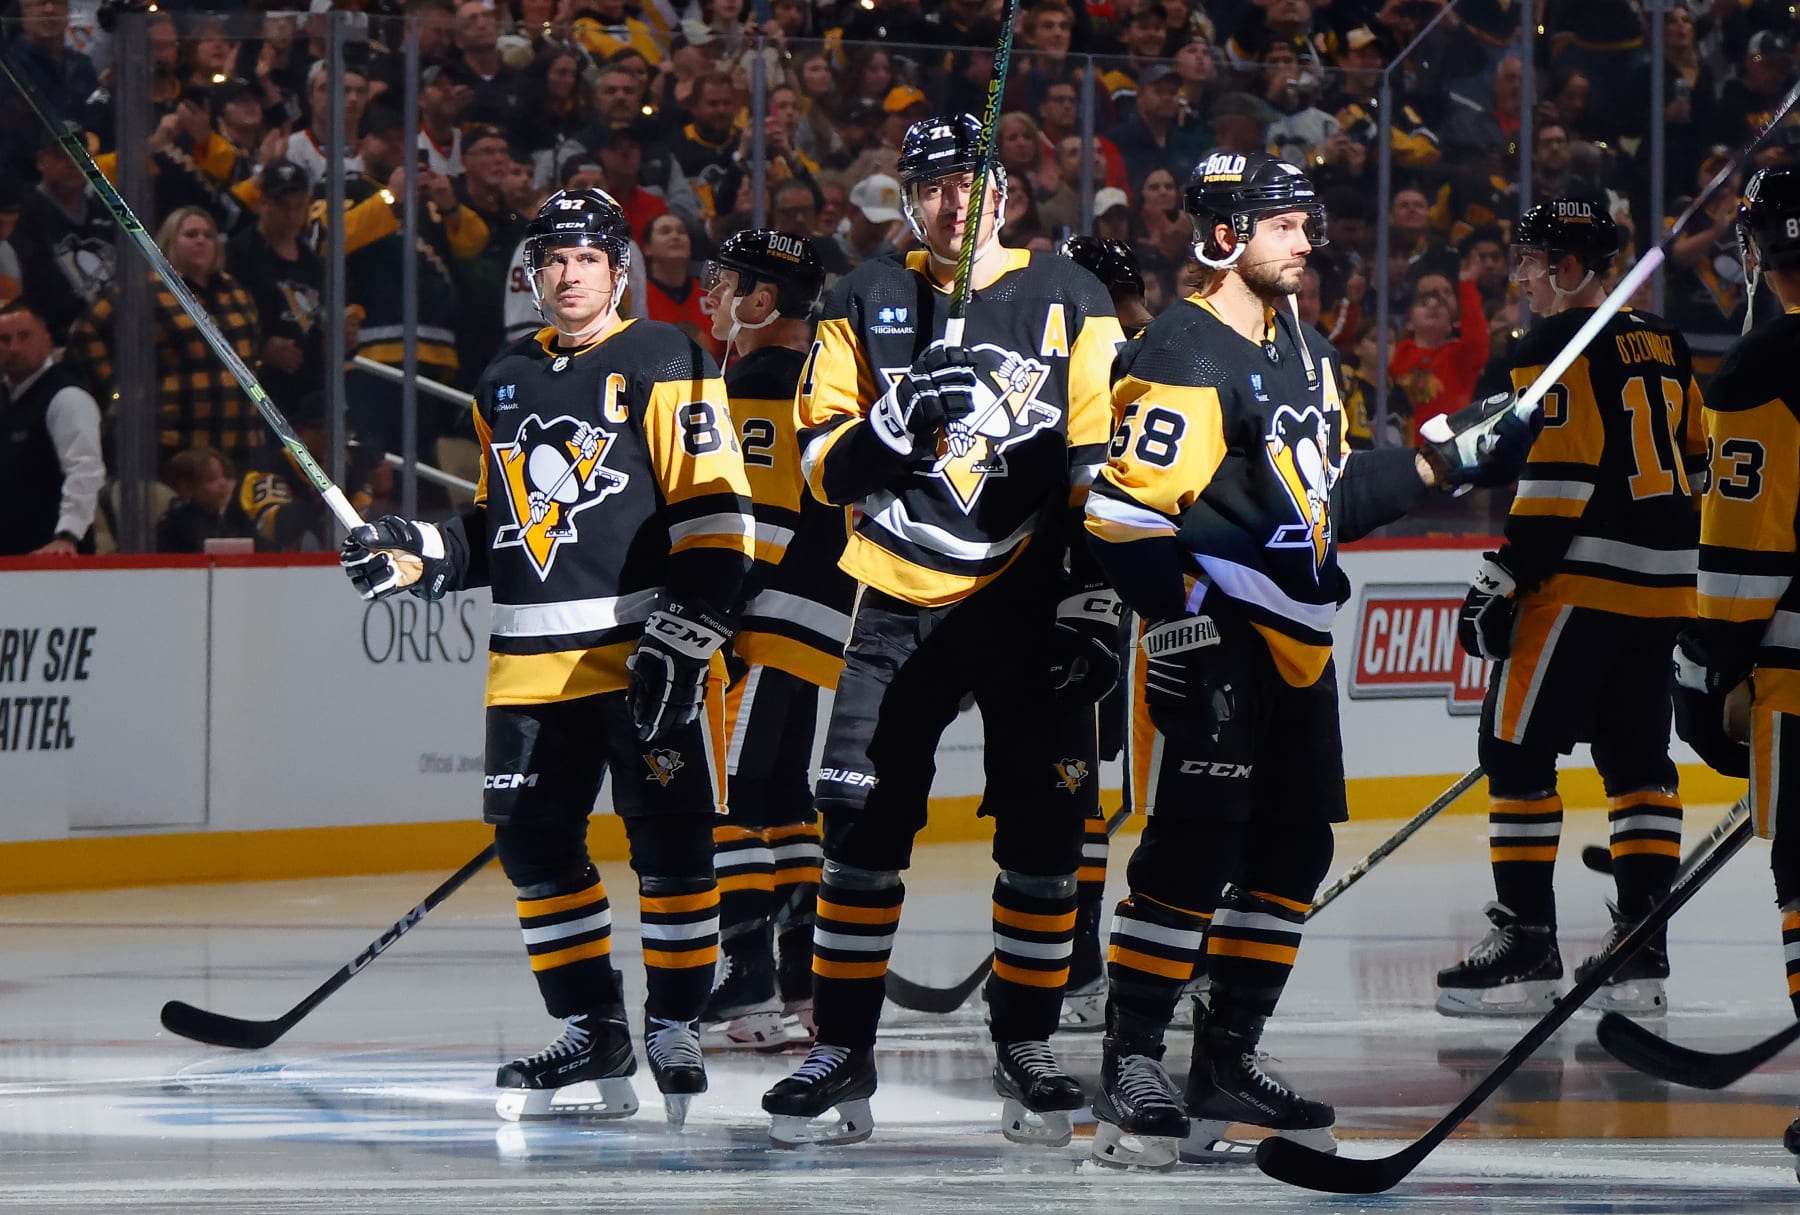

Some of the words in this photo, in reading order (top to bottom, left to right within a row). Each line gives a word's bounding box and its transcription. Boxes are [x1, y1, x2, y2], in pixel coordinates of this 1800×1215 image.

[977, 79, 999, 156] TACKS
[929, 125, 953, 140] 71
[1204, 153, 1247, 175] BOLD
[1203, 174, 1242, 183] PENGUIN
[560, 199, 585, 210] 87
[1558, 202, 1591, 217] BOLD
[766, 249, 801, 263] PENGUIN
[768, 234, 803, 257] BOLD
[872, 326, 914, 334] HIGHMARK
[1041, 303, 1069, 357] A
[1321, 357, 1341, 412] A
[604, 373, 629, 423] C
[1108, 402, 1189, 470] 58
[669, 602, 684, 614] 87
[361, 590, 476, 664] ORR'S
[700, 613, 734, 637] PENGUINS
[1179, 759, 1254, 779] CCM
[484, 773, 539, 789] CCM
[558, 1056, 590, 1074] CCM
[1239, 1091, 1277, 1116] BAUER
